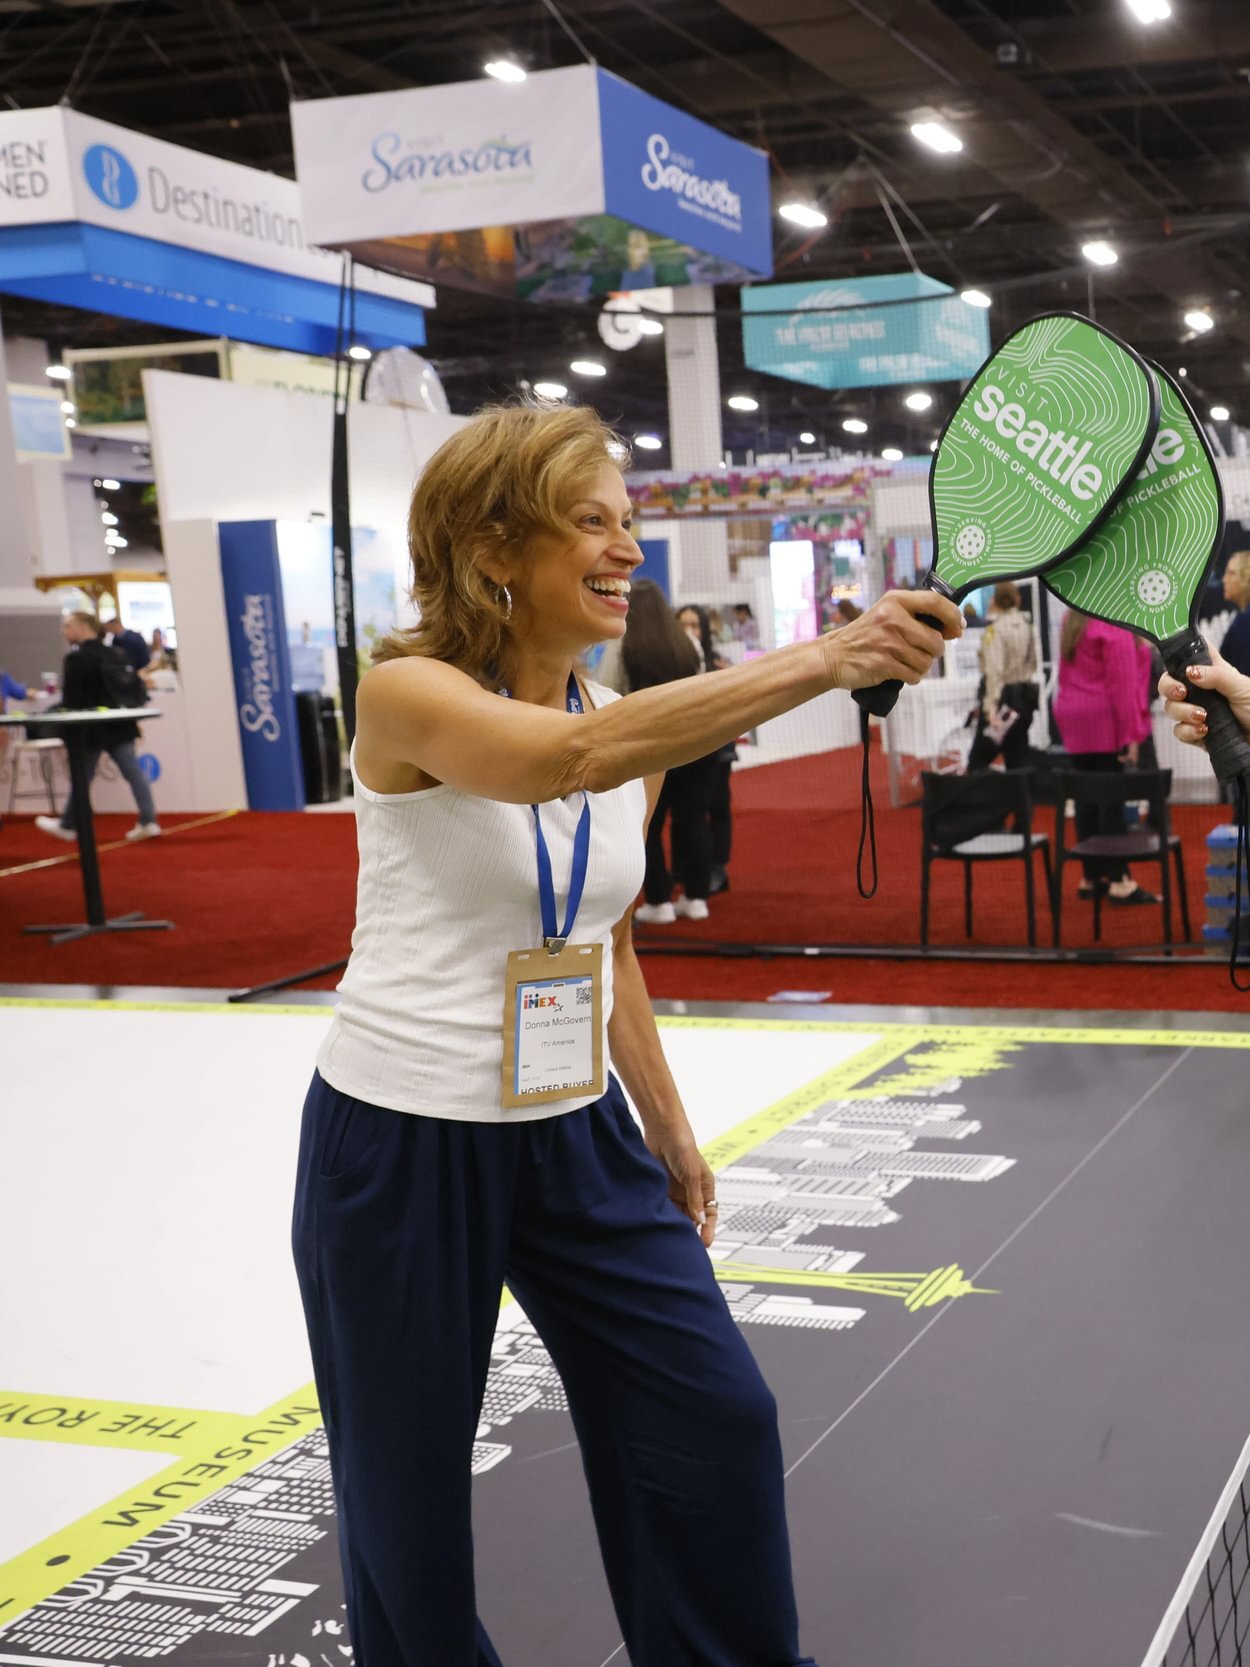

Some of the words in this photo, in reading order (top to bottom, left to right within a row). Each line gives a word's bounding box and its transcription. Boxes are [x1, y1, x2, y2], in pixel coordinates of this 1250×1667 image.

[361, 132, 534, 193] Sarasota
[641, 133, 741, 219] Sarasota
[147, 165, 303, 250] Destination
[998, 366, 1049, 412] VISIT
[960, 418, 981, 440] THE
[979, 435, 1011, 465] HOME
[1010, 460, 1027, 476] OF
[1025, 472, 1083, 525] PICKLEBALL
[973, 384, 1103, 501] Seattle
[1126, 463, 1201, 508] PICKLEBALL
[240, 594, 281, 743] Sarasota
[525, 1020, 550, 1031] Donna
[551, 1016, 592, 1027] McGovern
[0, 1402, 101, 1428] ROY
[98, 1414, 198, 1440] THE
[101, 1405, 321, 1529] MUSEUM
